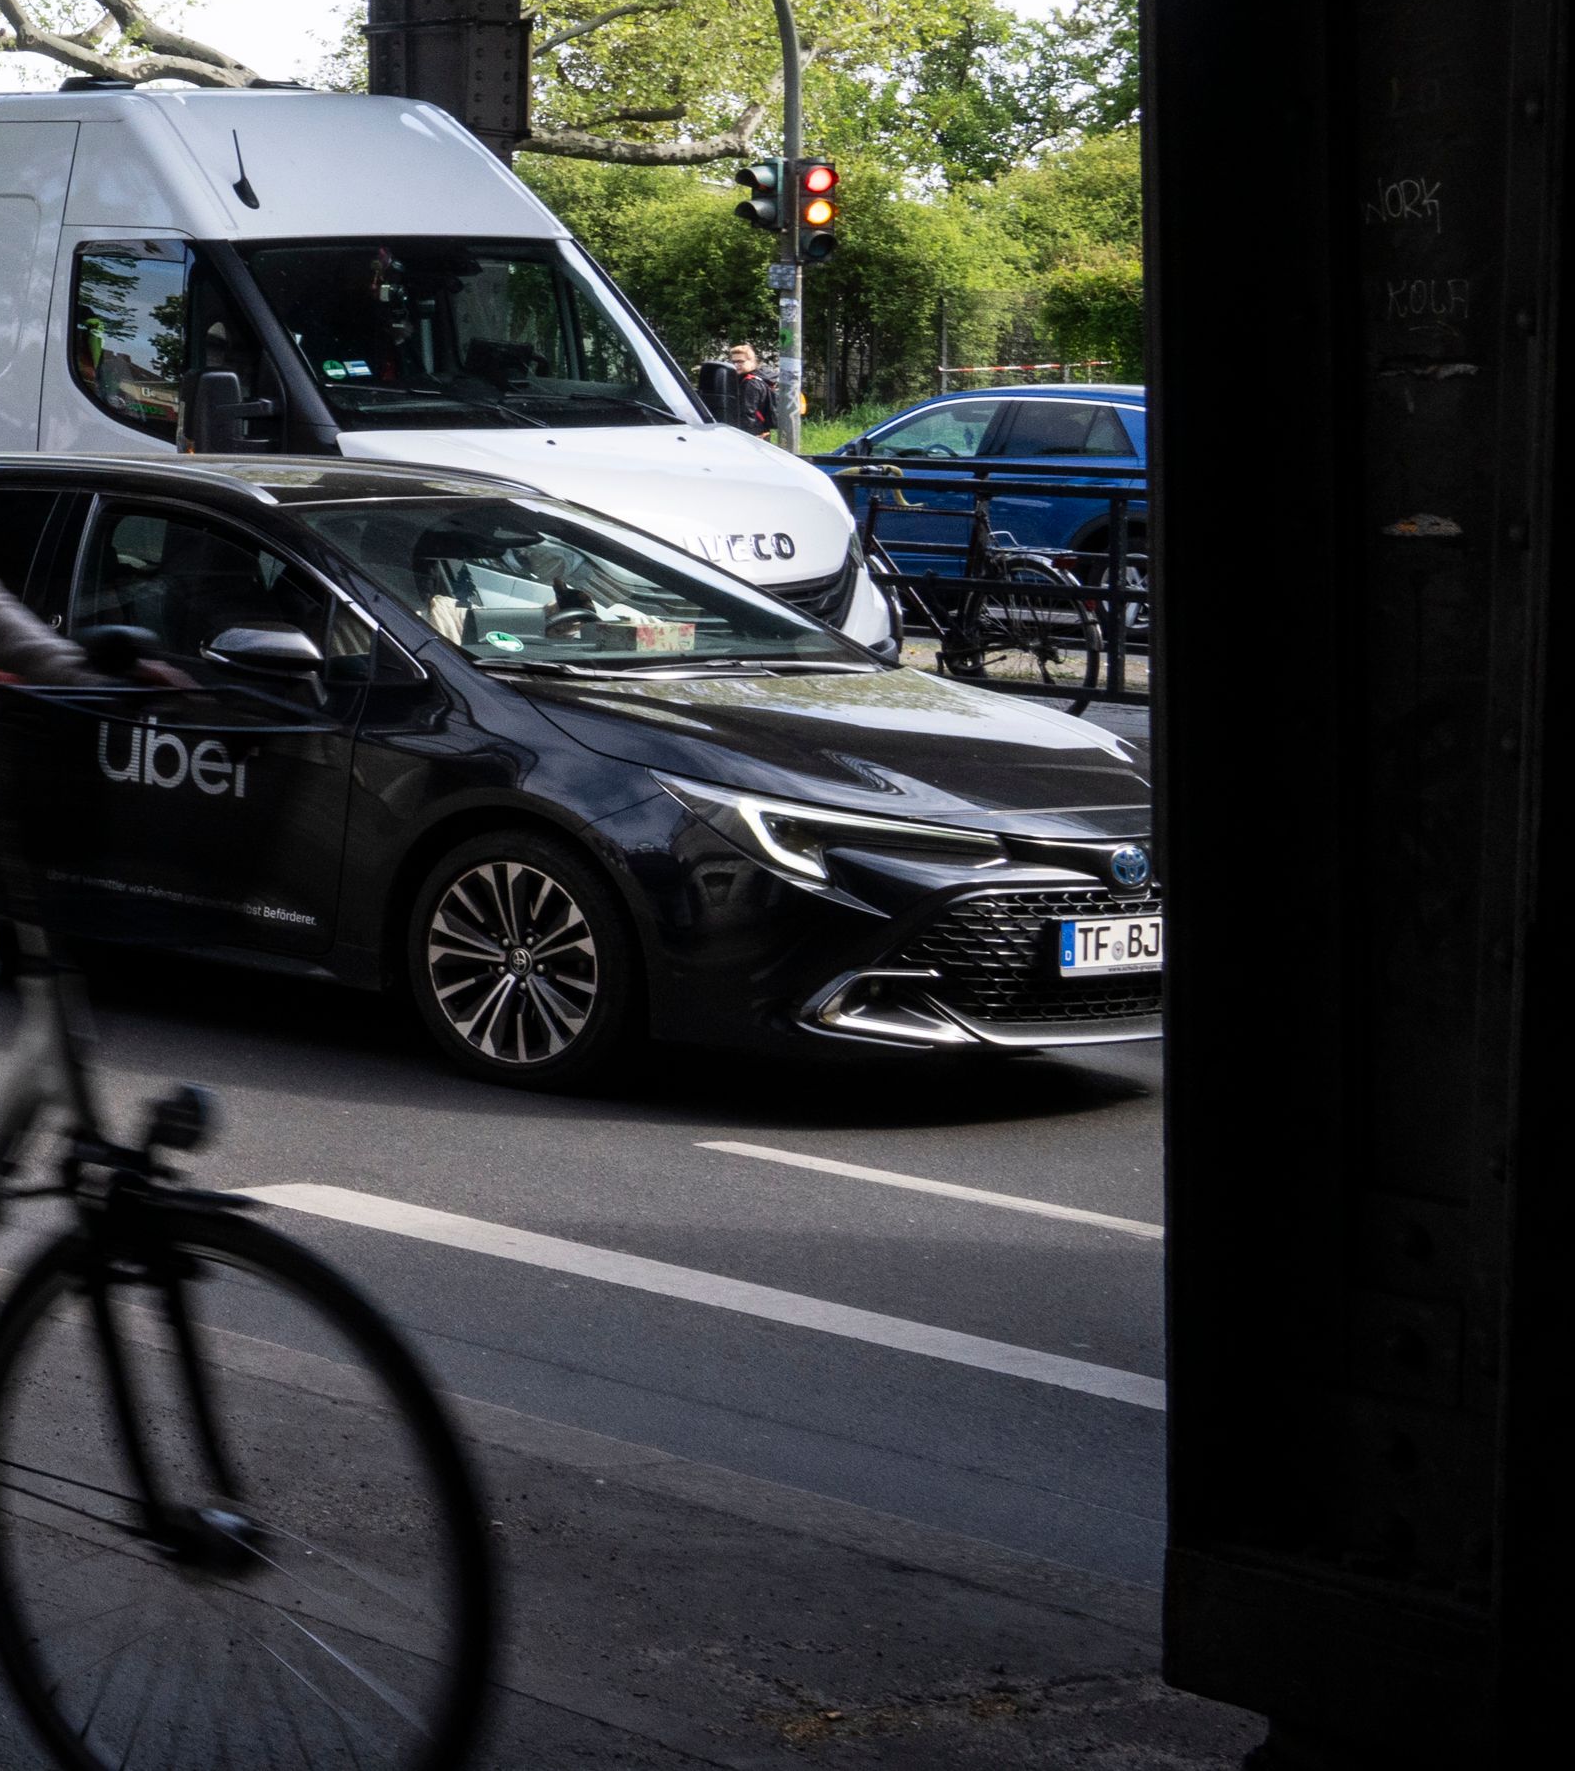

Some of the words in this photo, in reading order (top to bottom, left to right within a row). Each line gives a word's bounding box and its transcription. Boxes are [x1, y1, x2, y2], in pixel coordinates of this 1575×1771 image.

[98, 715, 260, 798] Uber
[1064, 950, 1072, 961] D
[1078, 925, 1112, 962] TF
[1127, 922, 1161, 959] BJ
